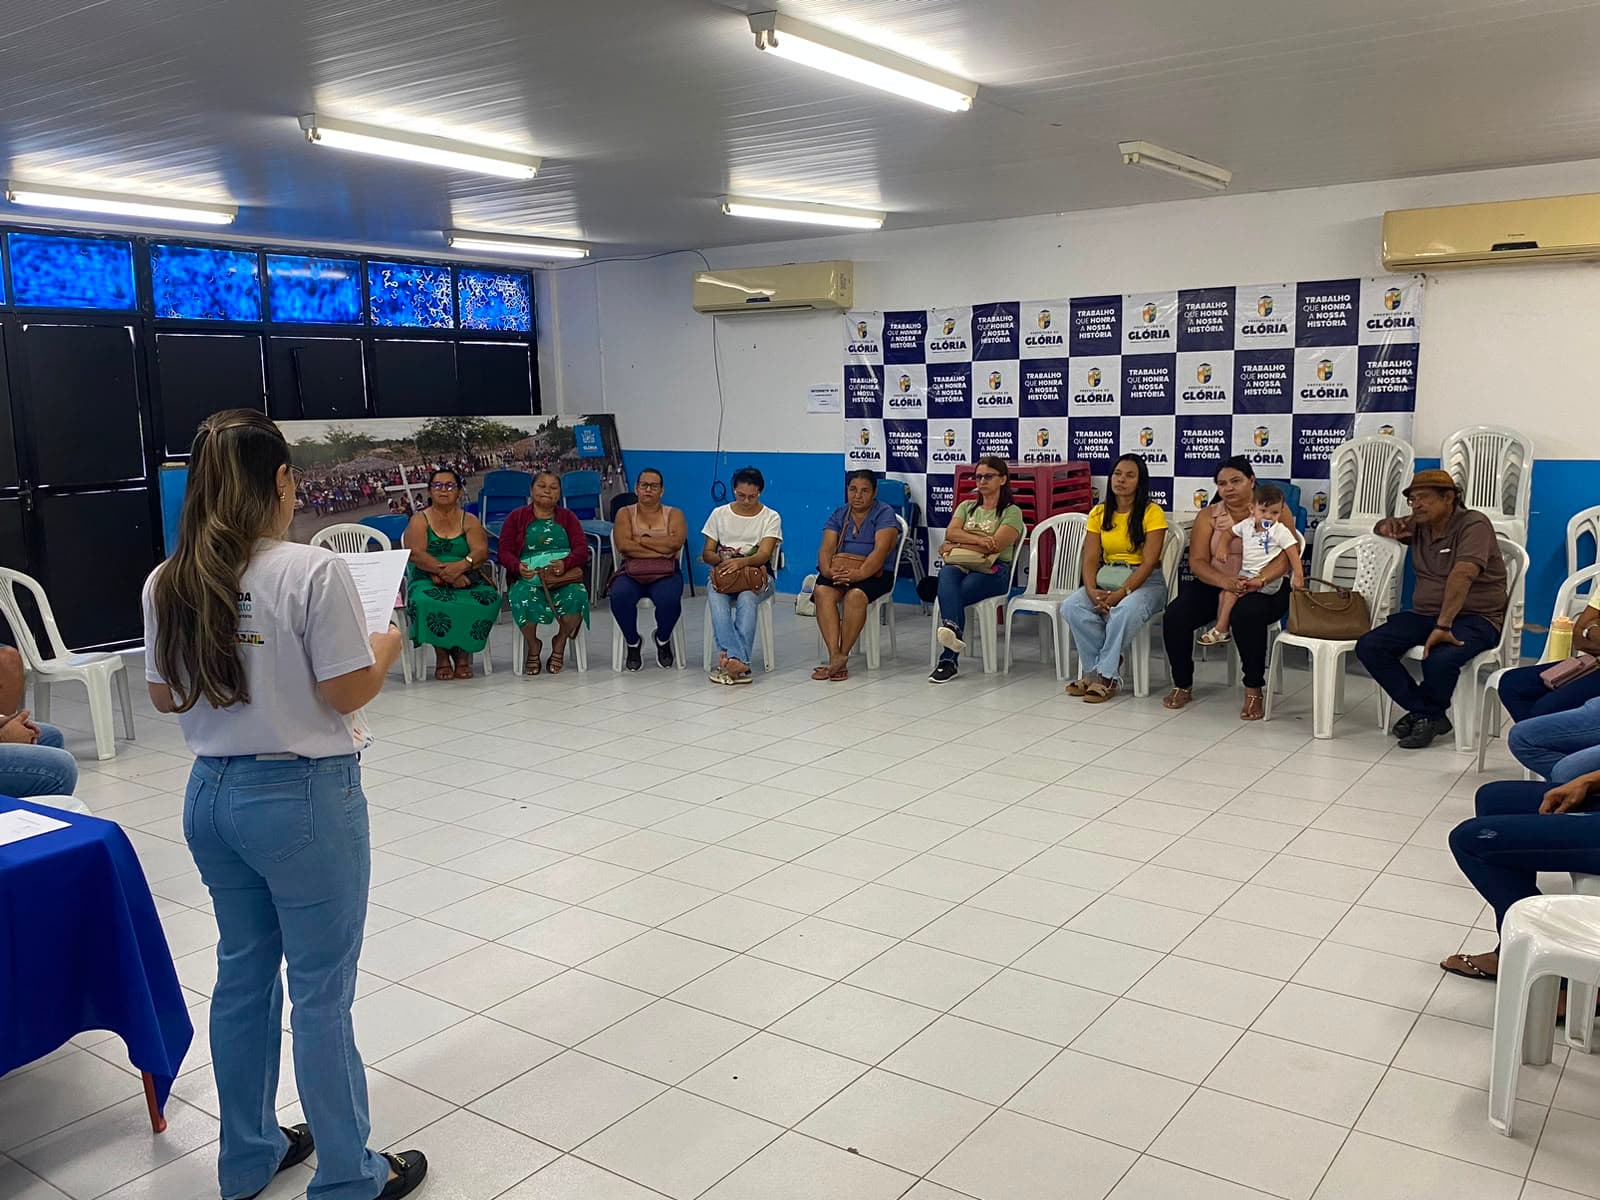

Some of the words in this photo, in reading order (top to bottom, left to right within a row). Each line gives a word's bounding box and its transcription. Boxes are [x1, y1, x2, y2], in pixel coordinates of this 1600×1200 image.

[1305, 295, 1350, 303] TRABALHO
[1307, 319, 1346, 327] HISTÓRIA
[1366, 317, 1415, 329] GLÓRIA
[1188, 325, 1224, 333] HISTÓRIA
[1242, 323, 1288, 334] GLÓRIA
[1079, 330, 1112, 339] HISTÓRIA
[1128, 329, 1170, 340] GLÓRIA
[930, 340, 967, 350] GLÓRIA
[1025, 335, 1063, 345] GLÓRIA
[848, 344, 878, 352] GLÓRIA
[1300, 387, 1348, 398] GLÓRIA
[1368, 384, 1408, 392] HISTÓRIA
[977, 395, 1013, 404] GLÓRIA
[1074, 392, 1114, 402] GLÓRIA
[1183, 390, 1226, 400] GLÓRIA
[889, 397, 922, 406] GLÓRIA
[850, 450, 880, 459] GLÓRIA
[932, 452, 966, 461] GLÓRIA
[1024, 452, 1061, 463] GLÓRIA
[1140, 452, 1168, 462] ÓRIA
[1243, 452, 1284, 463] LÓRIA
